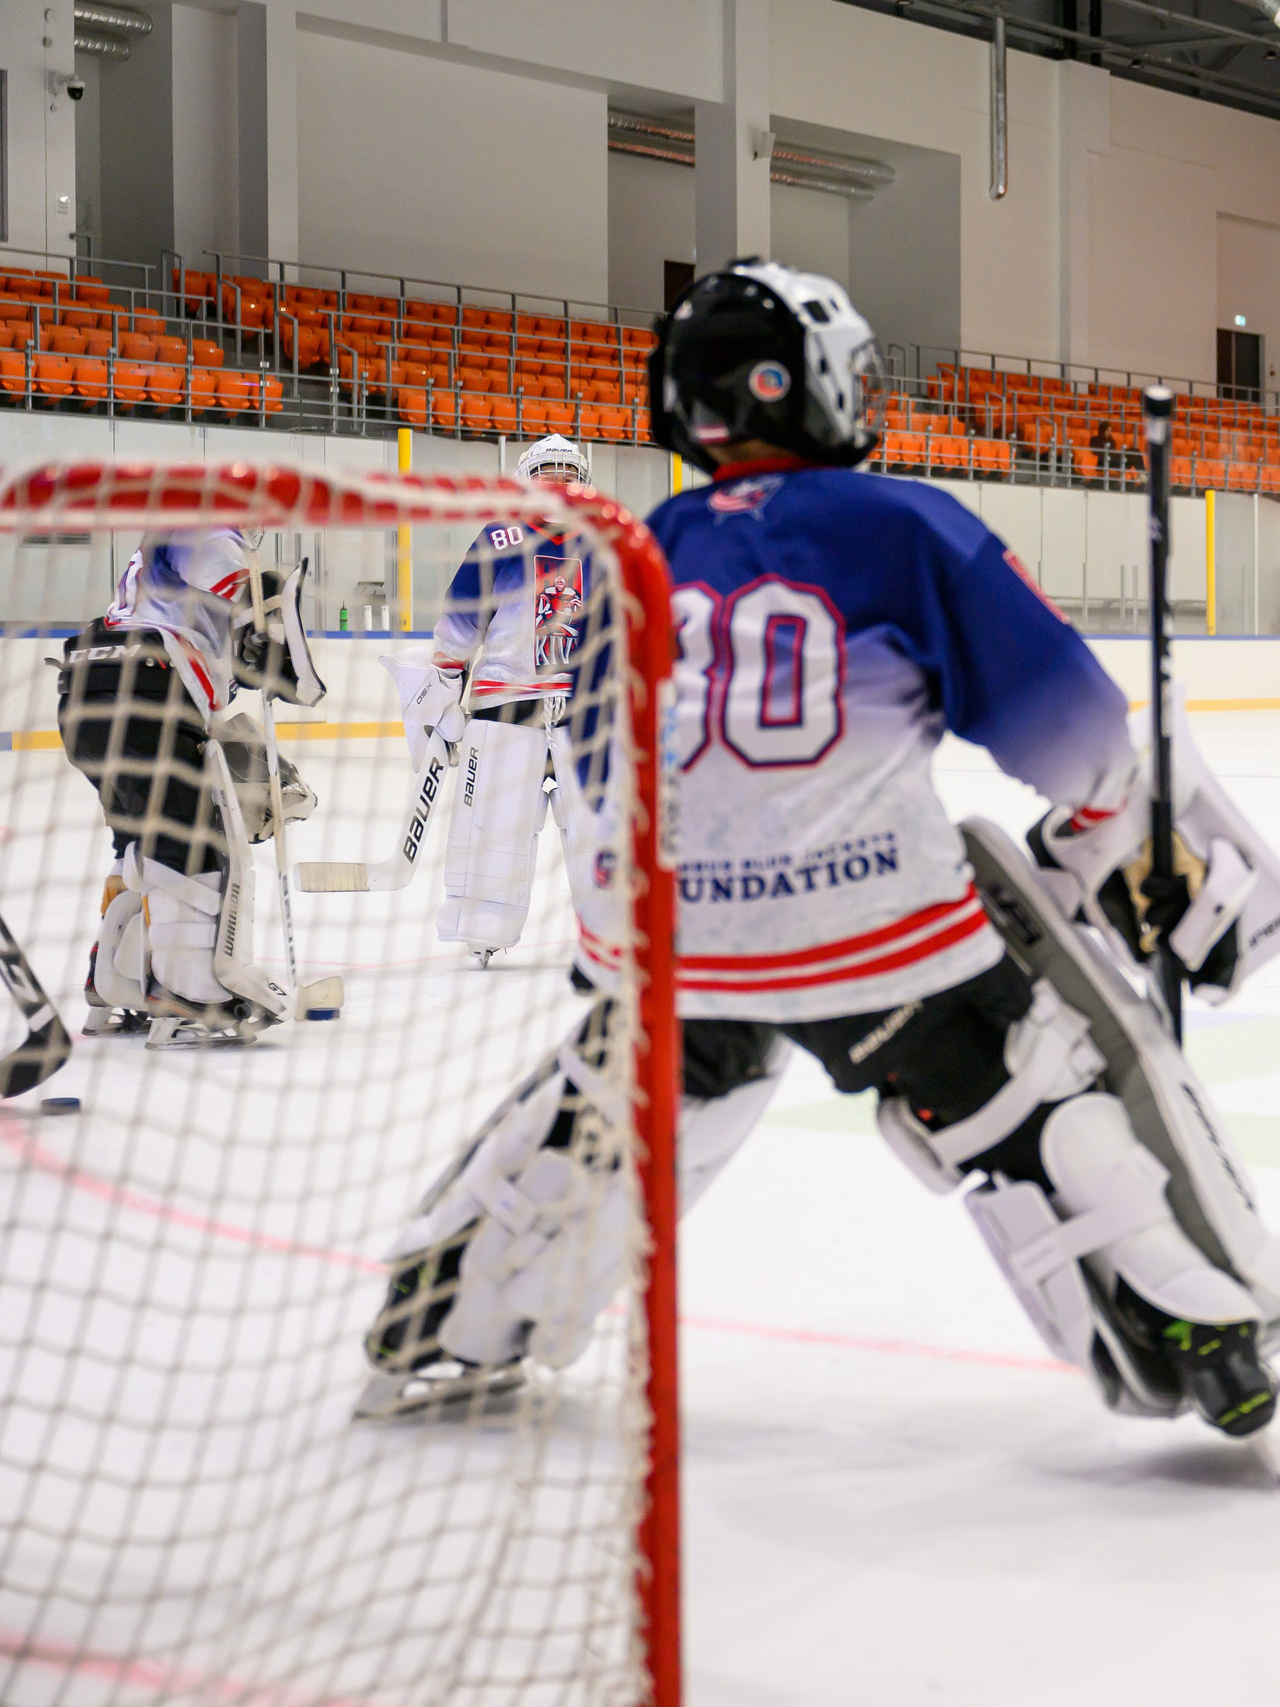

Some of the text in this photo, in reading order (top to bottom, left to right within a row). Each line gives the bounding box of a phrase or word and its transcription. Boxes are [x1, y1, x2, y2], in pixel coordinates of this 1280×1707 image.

[491, 526, 524, 550] 80
[464, 747, 479, 807] BAUER
[403, 756, 444, 864] BAUER
